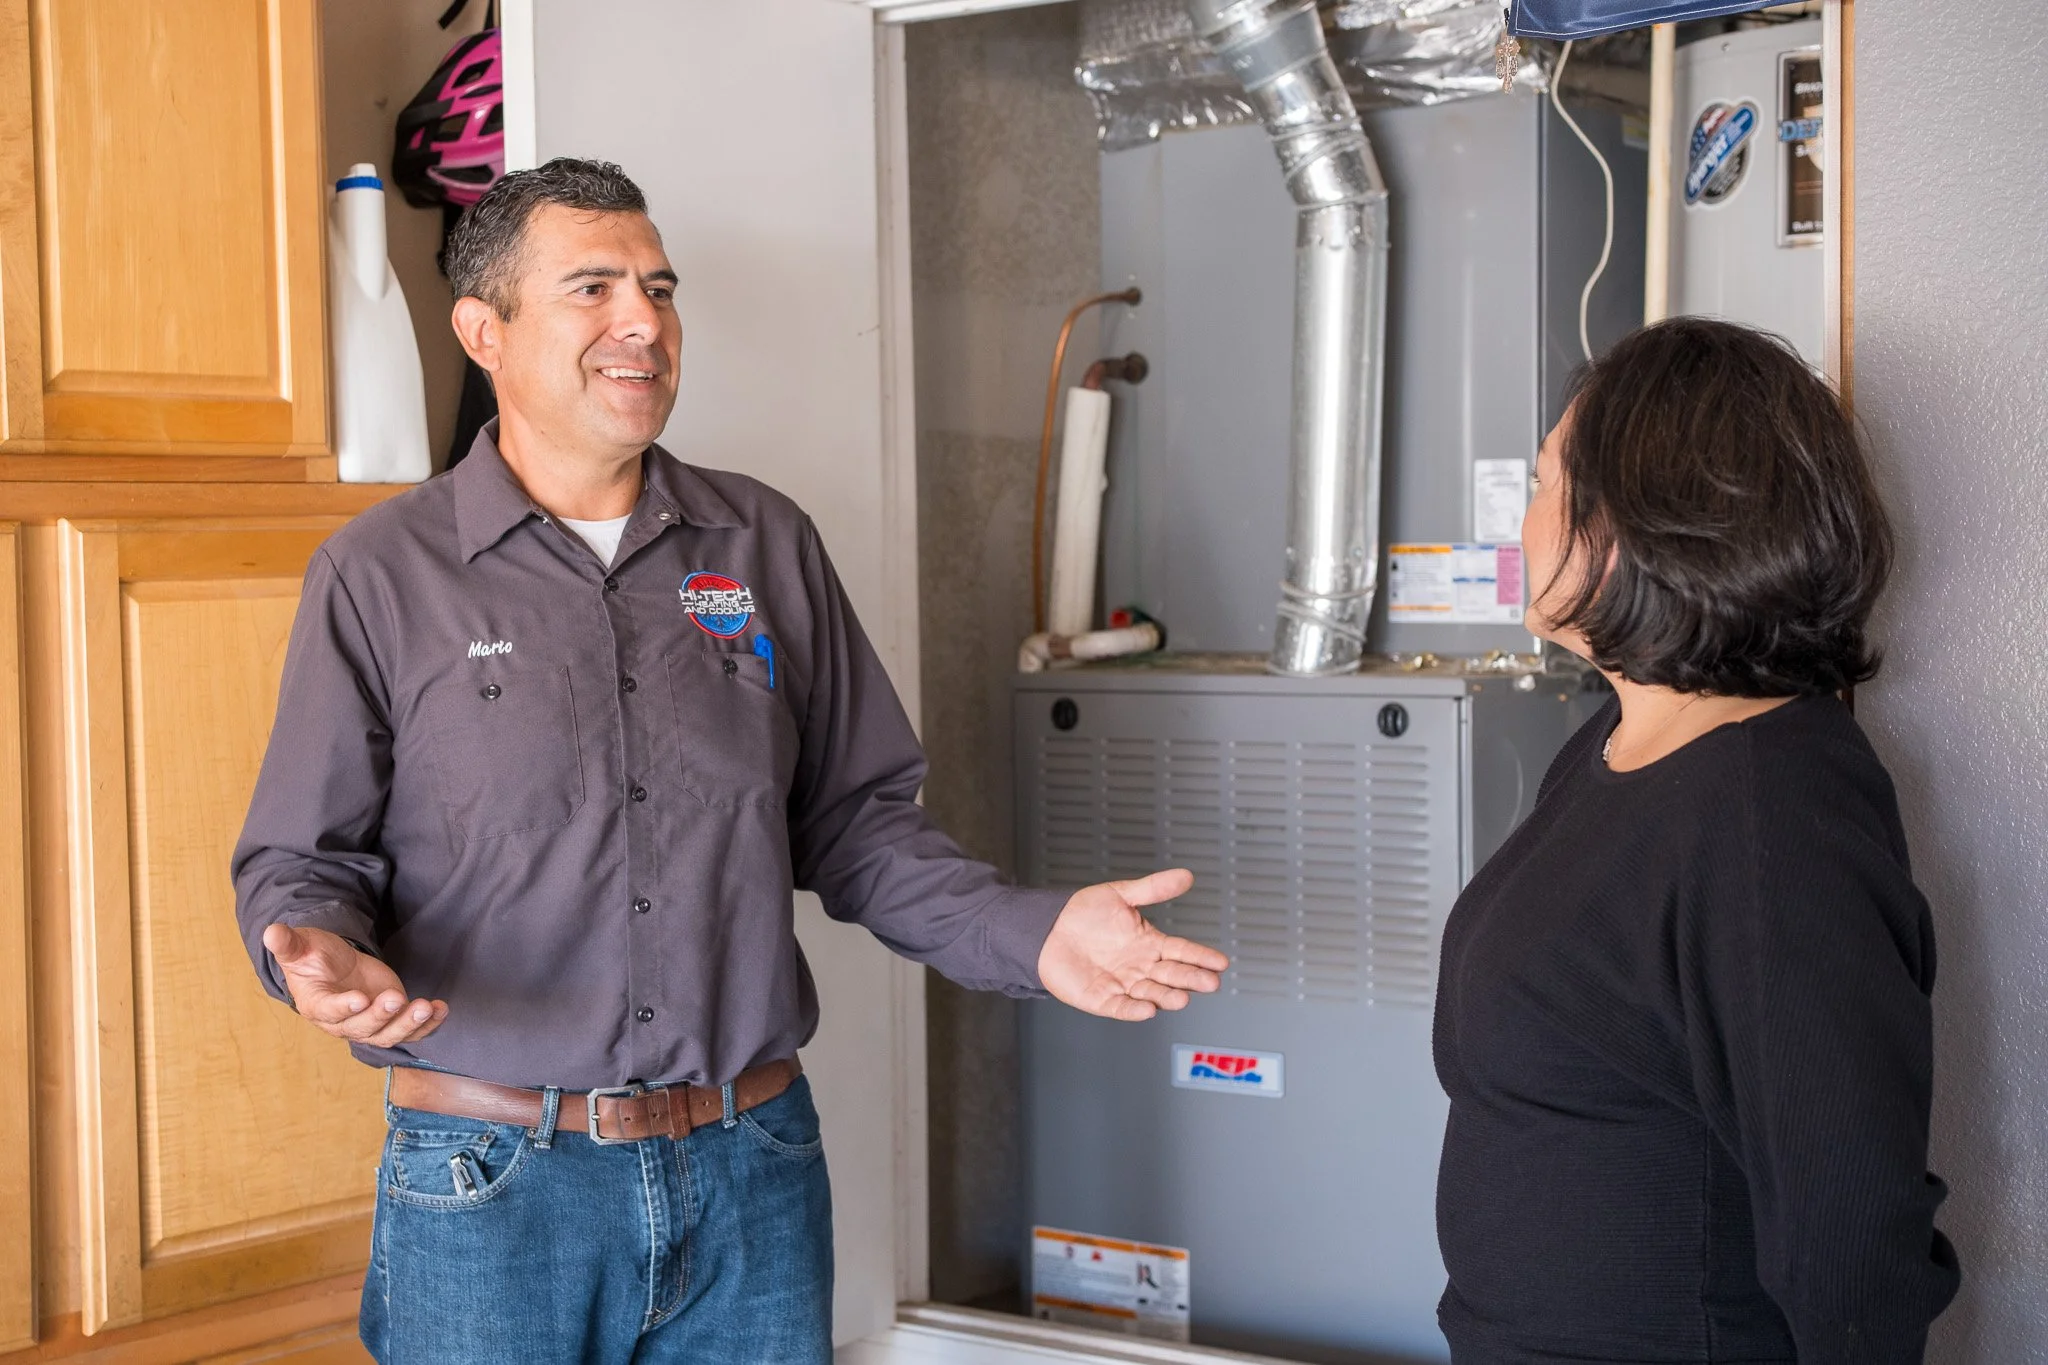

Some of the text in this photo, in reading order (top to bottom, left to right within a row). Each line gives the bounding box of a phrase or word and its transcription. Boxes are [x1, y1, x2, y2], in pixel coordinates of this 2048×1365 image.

[694, 600, 740, 608] HEATING
[684, 605, 756, 615] AND COOLING
[467, 640, 513, 659] Mario
